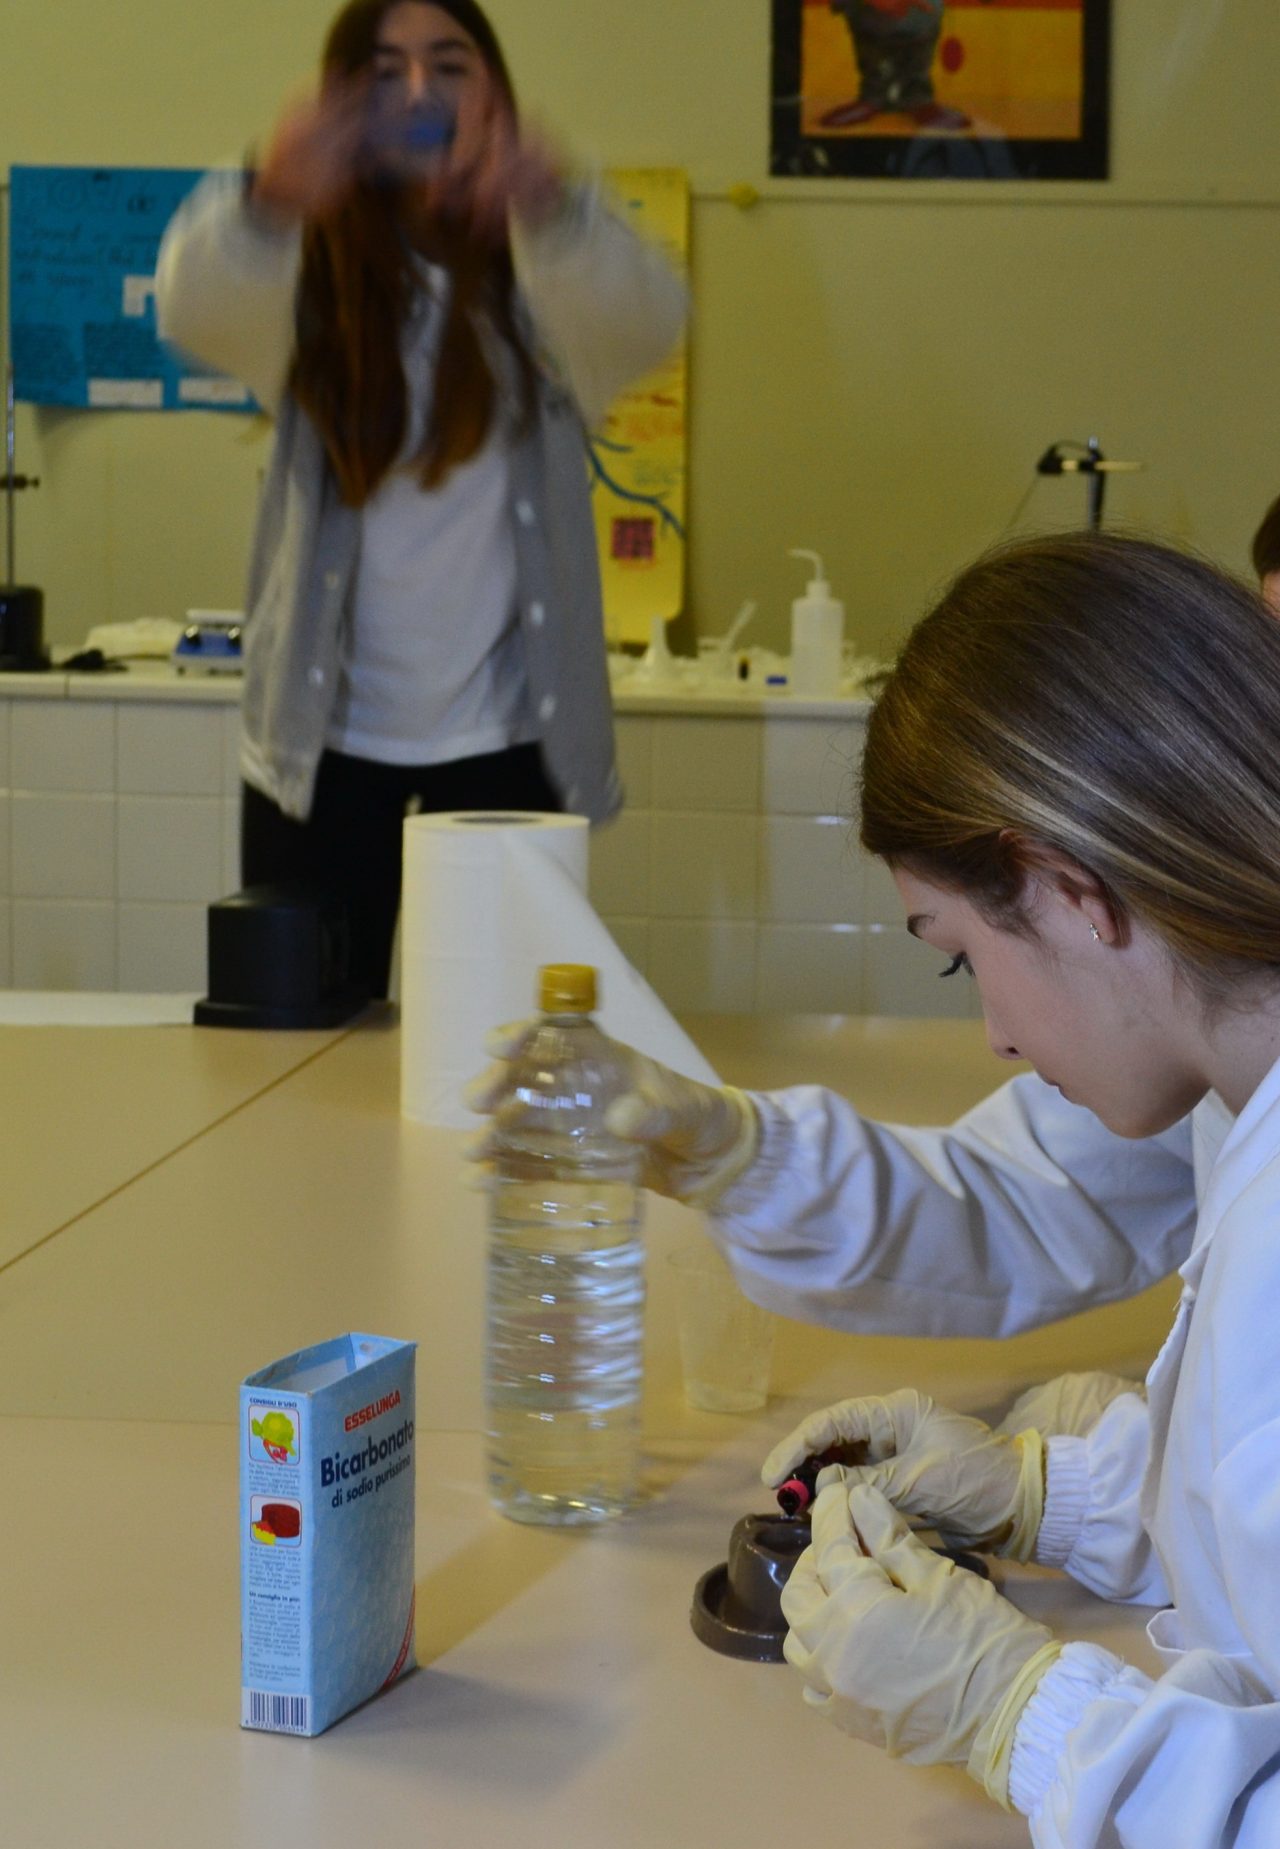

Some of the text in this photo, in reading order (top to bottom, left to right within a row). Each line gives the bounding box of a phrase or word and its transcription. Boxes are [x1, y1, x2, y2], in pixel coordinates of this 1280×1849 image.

[345, 1390, 401, 1432] ESSELUNGA
[320, 1419, 414, 1487] Bicarbonato
[332, 1488, 343, 1508] di
[346, 1476, 373, 1502] sodio
